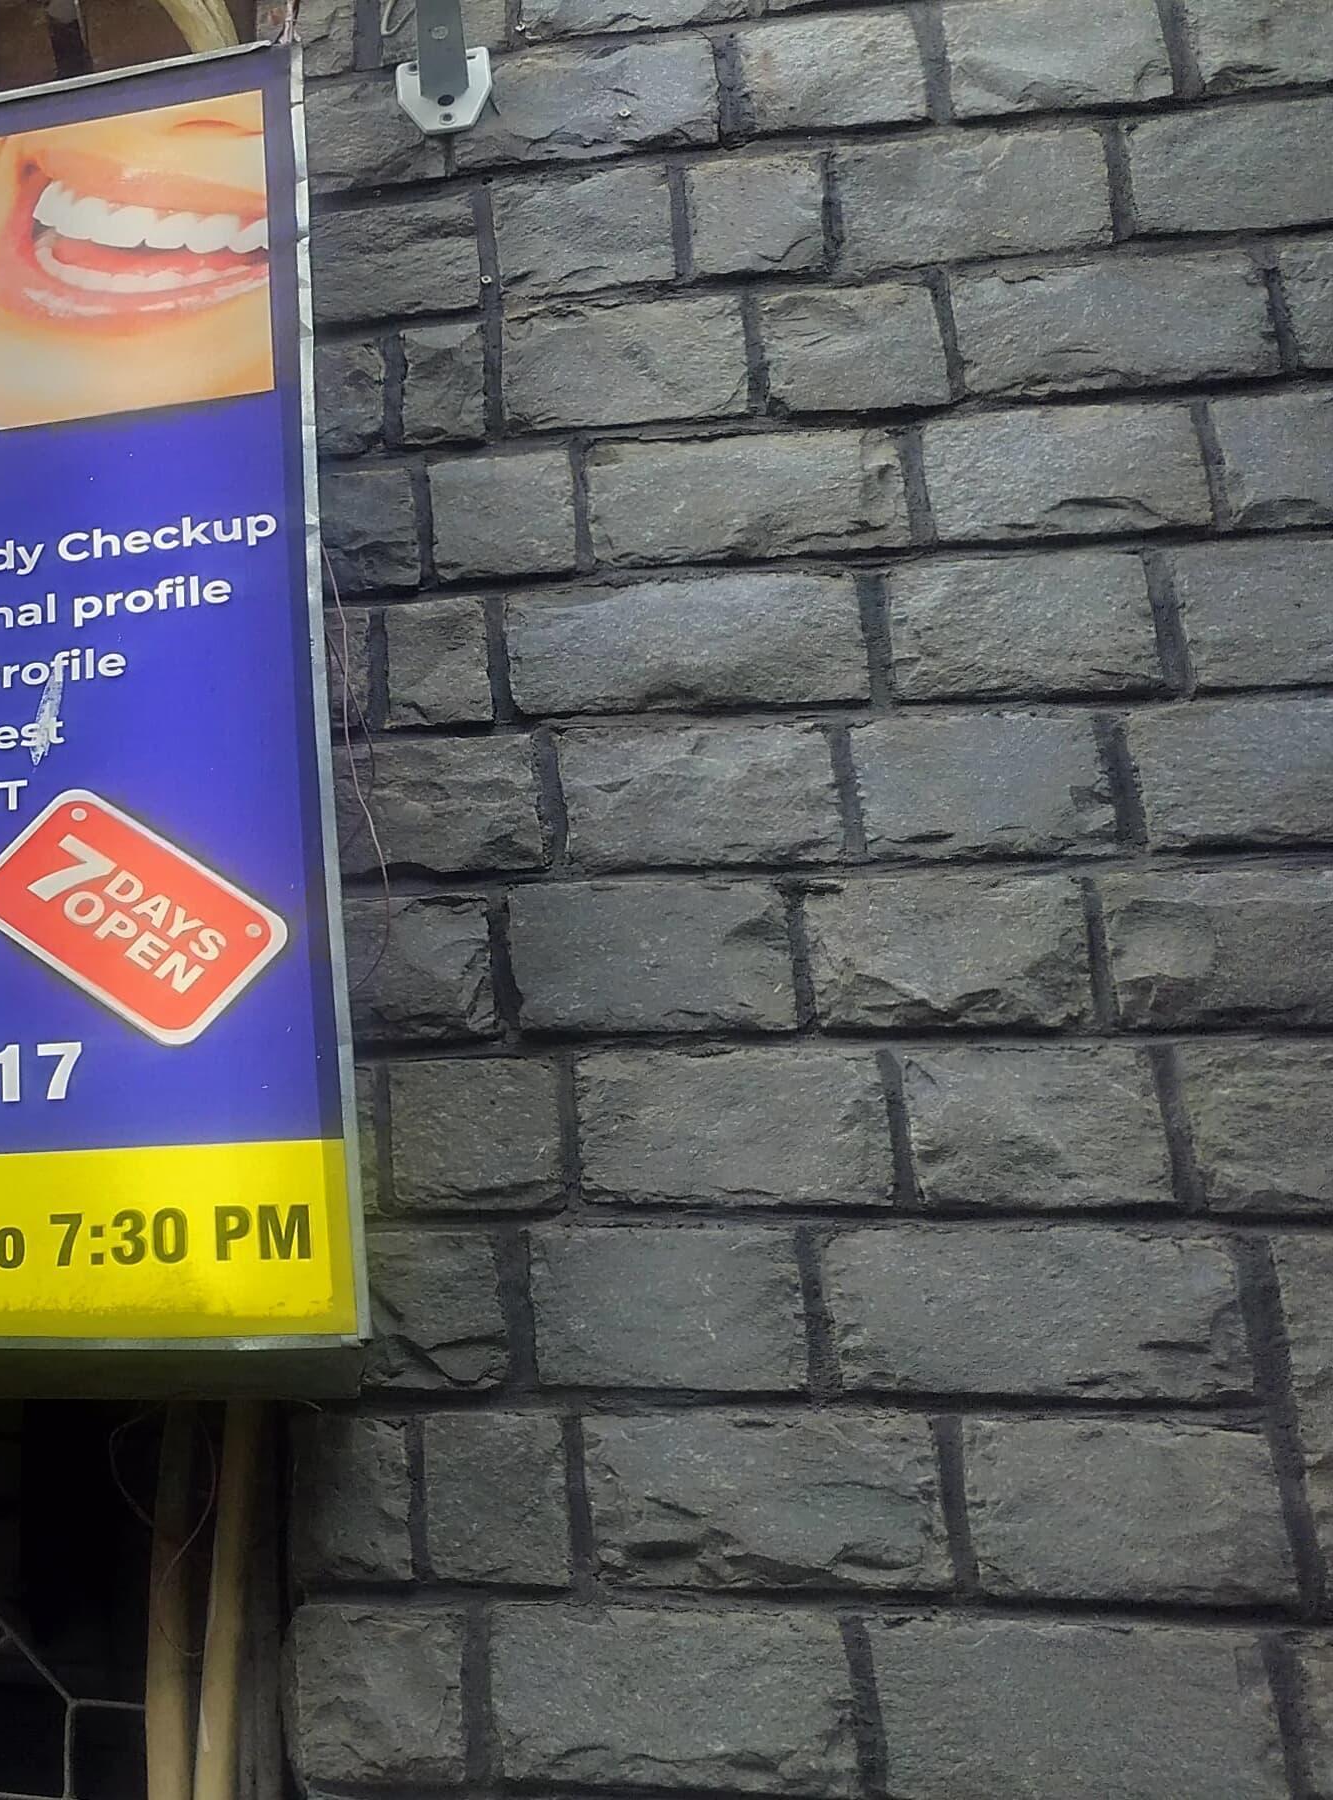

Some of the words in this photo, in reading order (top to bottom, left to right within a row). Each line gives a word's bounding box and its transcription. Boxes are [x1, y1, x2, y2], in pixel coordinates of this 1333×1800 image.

[57, 514, 277, 562] Checkup
[73, 575, 232, 628] profile
[26, 833, 118, 902] 7
[103, 868, 228, 961] DAYS
[63, 890, 205, 994] OPEN
[49, 1207, 188, 1267] 7:30
[214, 1203, 312, 1261] PM
